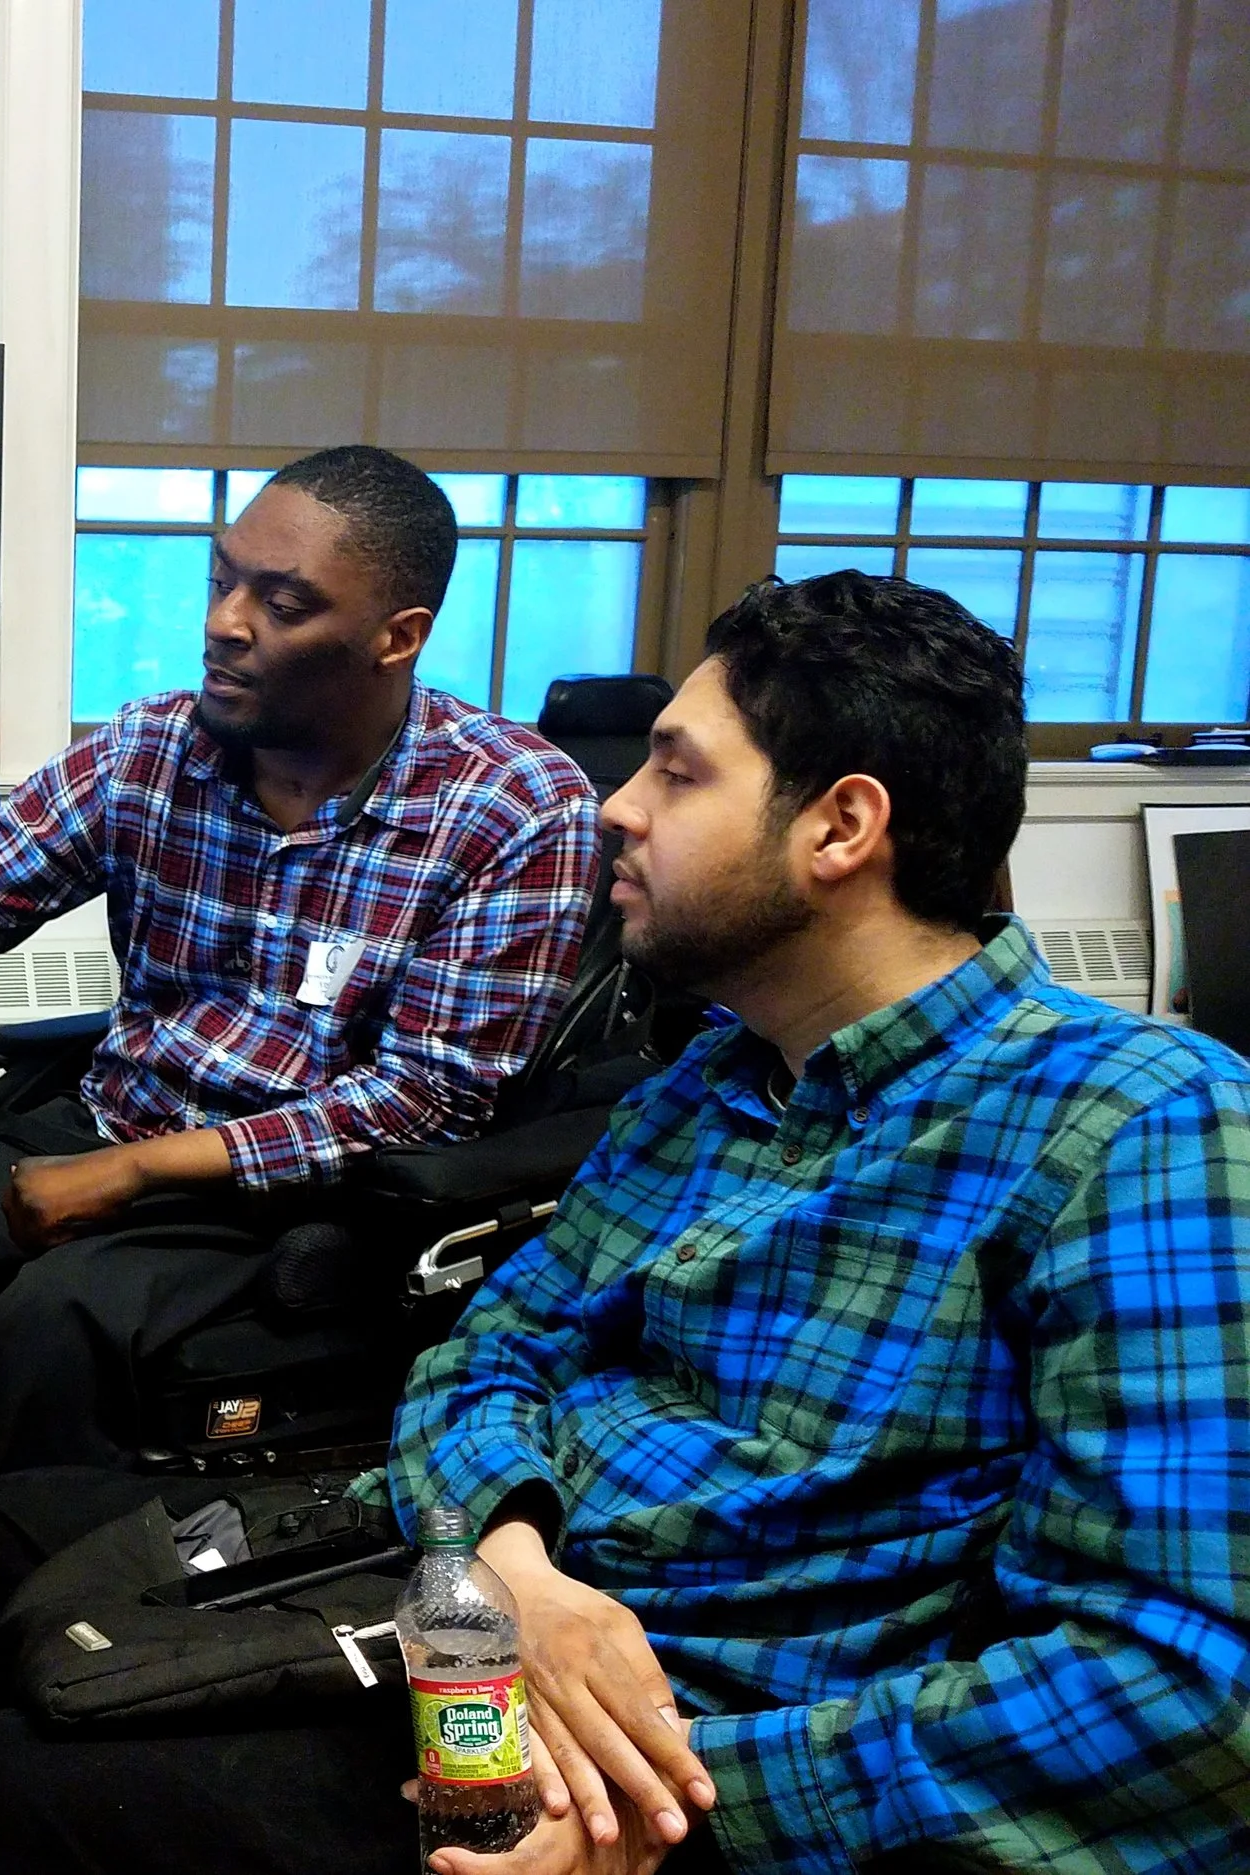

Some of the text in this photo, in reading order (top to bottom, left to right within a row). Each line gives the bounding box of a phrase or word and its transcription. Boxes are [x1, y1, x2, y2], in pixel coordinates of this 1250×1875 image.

[217, 1399, 240, 1414] JAY
[439, 1686, 477, 1695] raspberry
[446, 1707, 493, 1722] Poland
[443, 1720, 500, 1744] Spring
